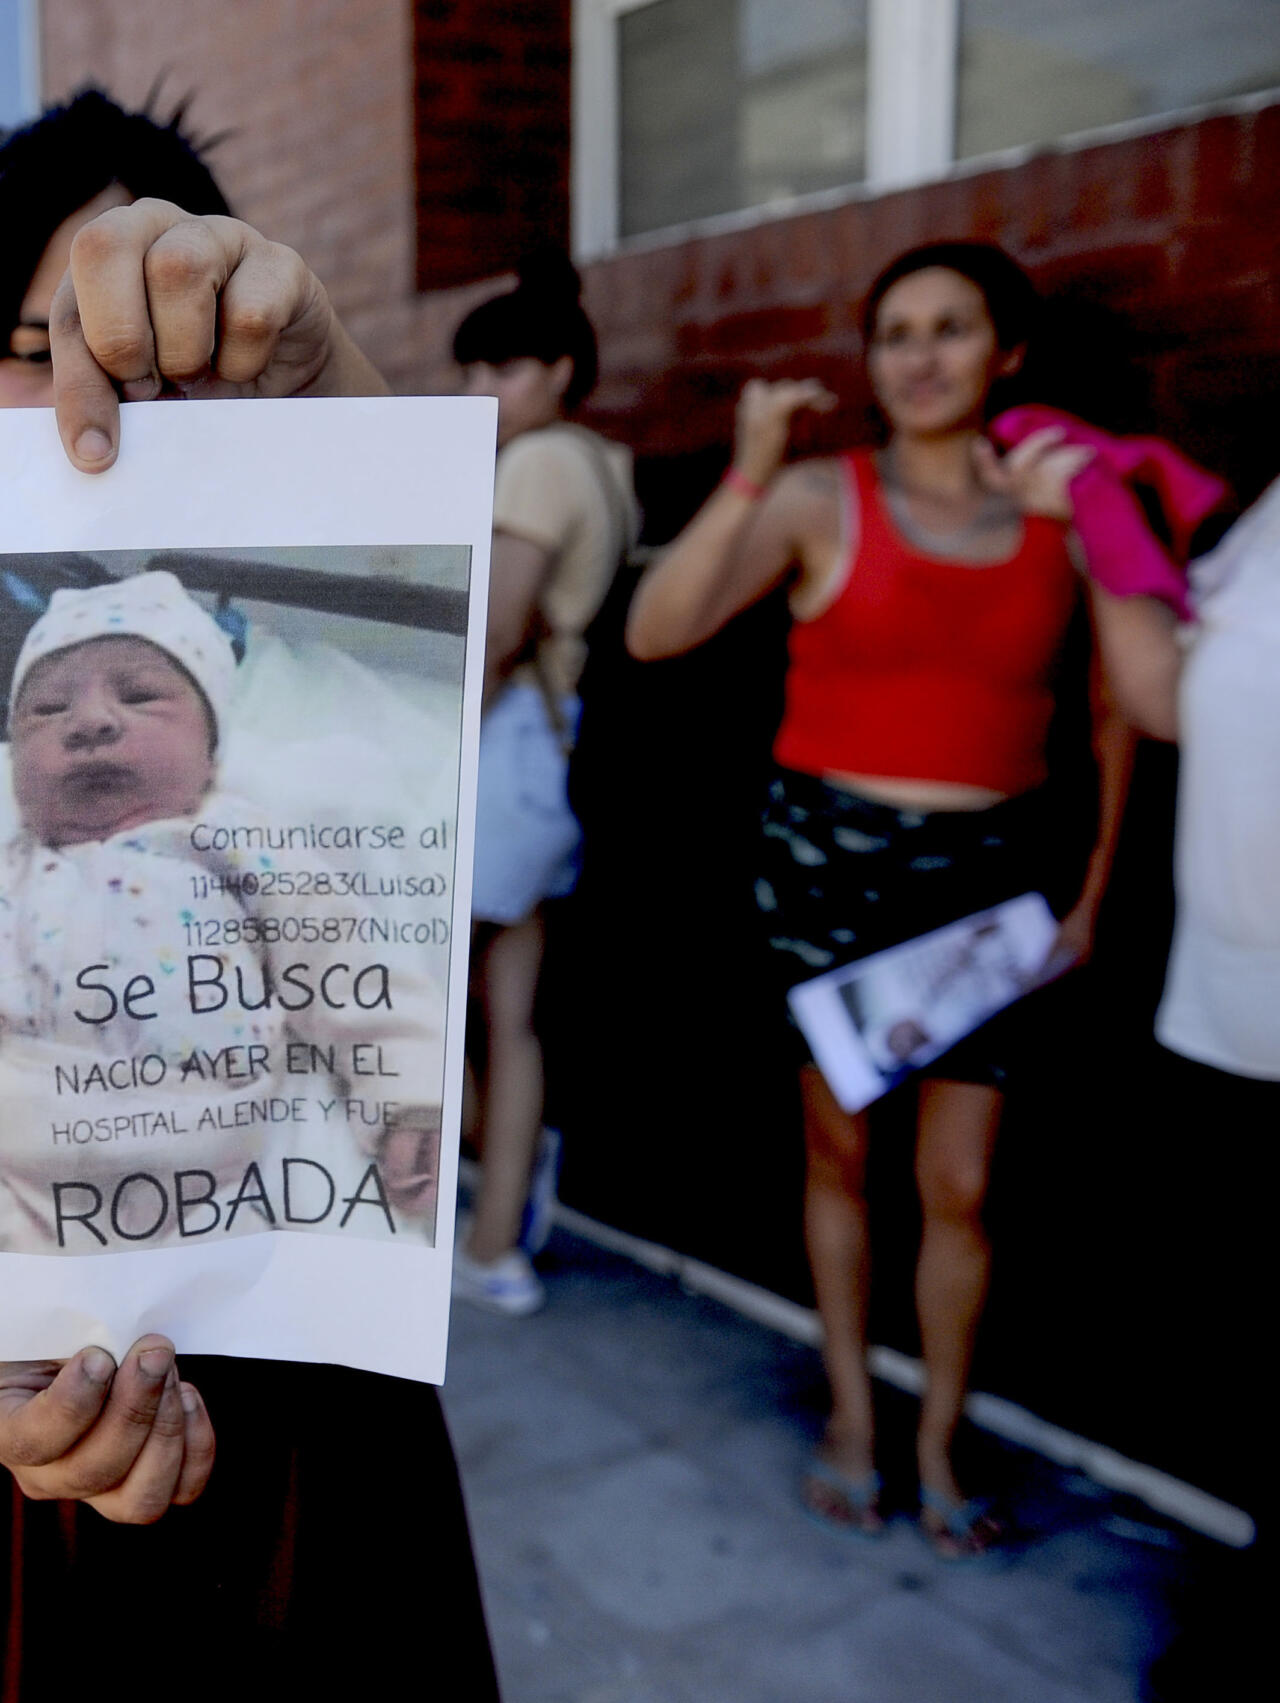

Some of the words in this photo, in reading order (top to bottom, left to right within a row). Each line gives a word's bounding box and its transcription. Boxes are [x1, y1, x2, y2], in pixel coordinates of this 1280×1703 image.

[190, 823, 406, 852] Comunicarse
[419, 820, 448, 849] al
[74, 965, 158, 1025] Se
[187, 955, 394, 1014] Busca
[55, 1054, 167, 1096] NACIO
[181, 1045, 270, 1082] AYER
[286, 1043, 335, 1075] EN
[352, 1044, 400, 1077] EL
[52, 1111, 188, 1145] HOSPITAL
[197, 1098, 308, 1131] ALENDE
[319, 1100, 337, 1122] Y
[345, 1100, 401, 1127] FUE
[51, 1157, 398, 1248] ROBADA
